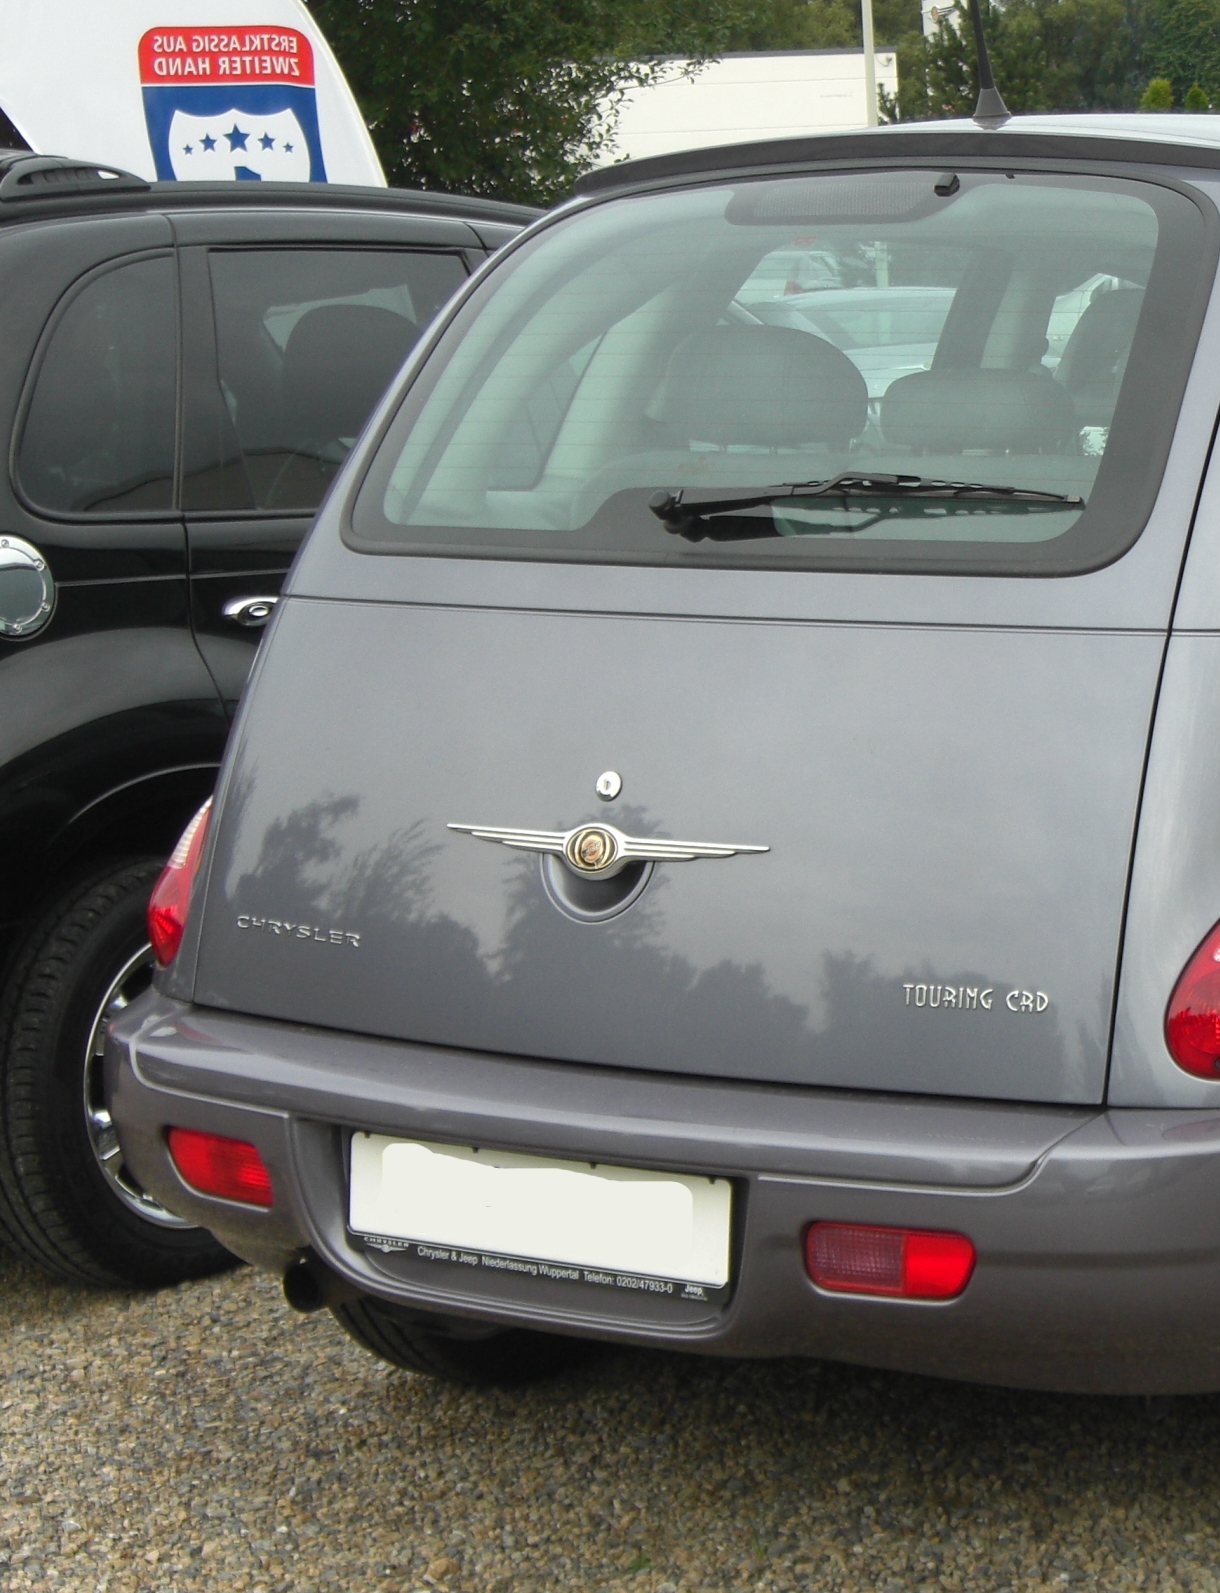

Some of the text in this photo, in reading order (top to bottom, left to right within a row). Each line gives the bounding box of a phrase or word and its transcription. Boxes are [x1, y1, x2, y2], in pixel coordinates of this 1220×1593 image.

[237, 915, 360, 948] CHRYSLER
[902, 984, 1049, 1013] TOURING CRD
[363, 1236, 410, 1249] CHRYSLER
[417, 1246, 673, 1294] Chrysler & Jeep Niederlassung Wuppertal Telefon: 0202/47933-0
